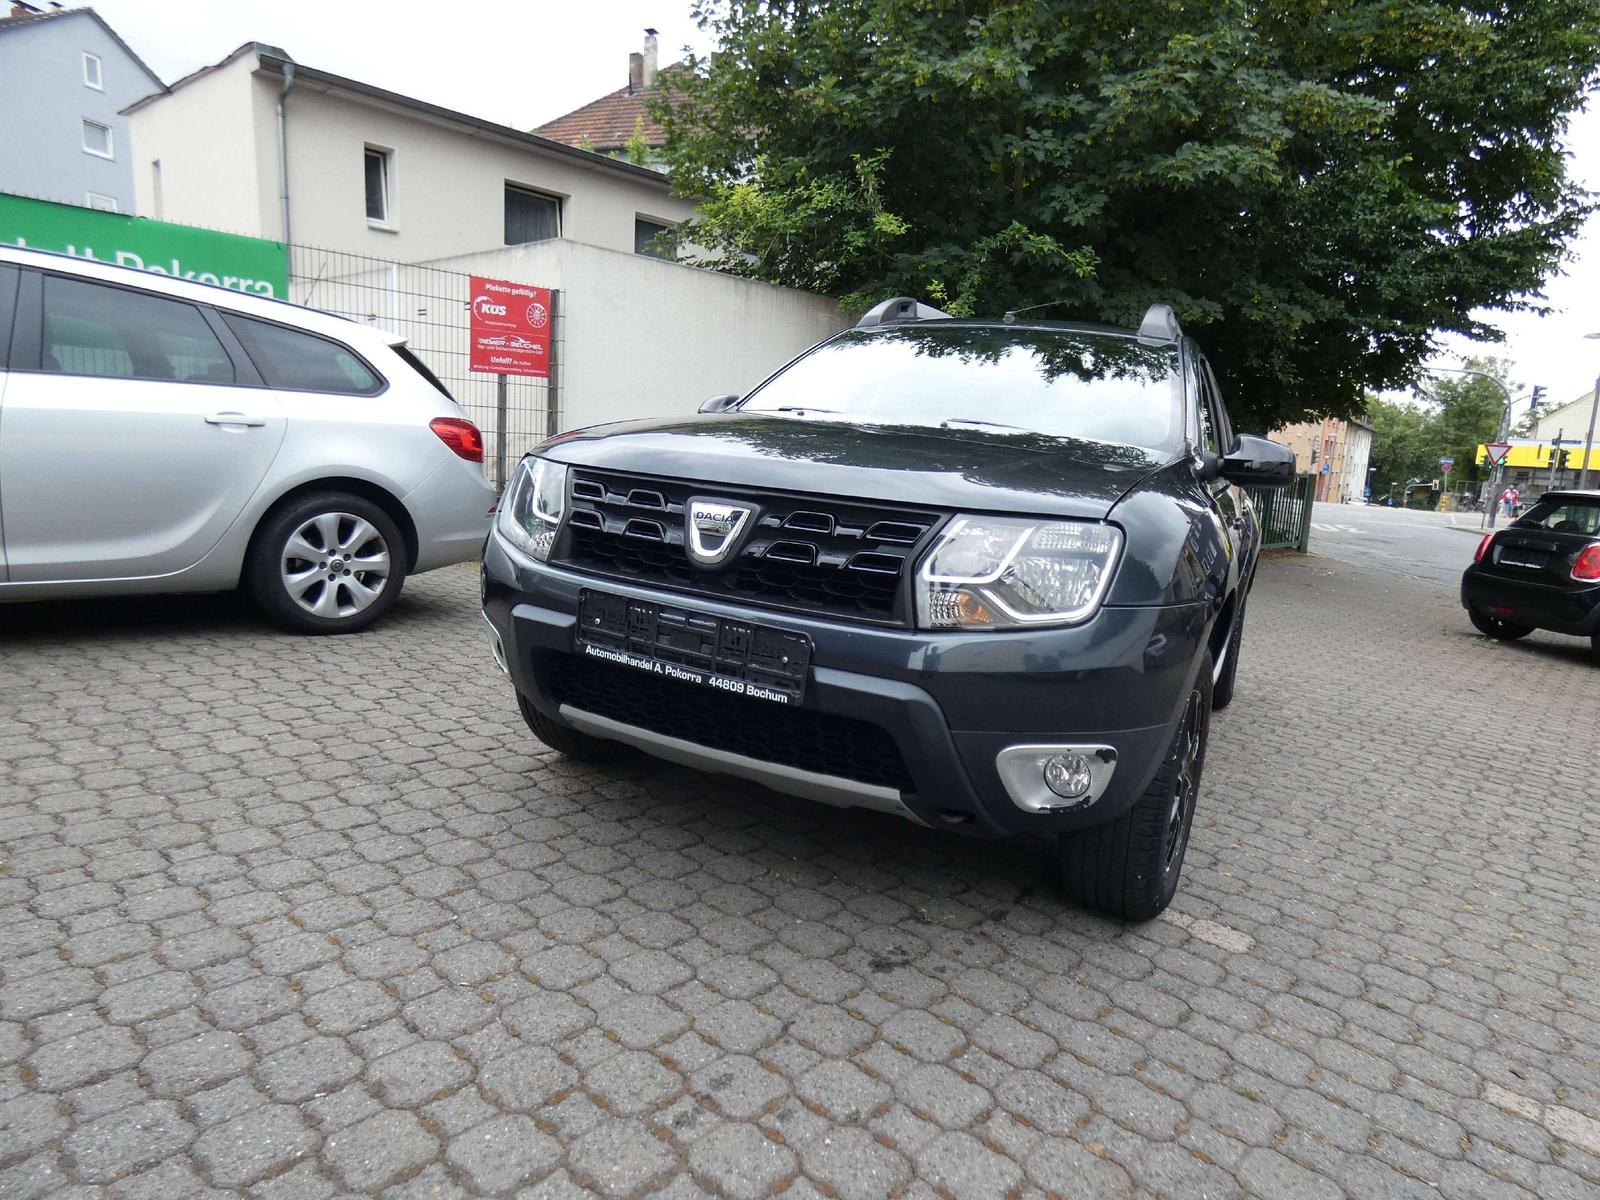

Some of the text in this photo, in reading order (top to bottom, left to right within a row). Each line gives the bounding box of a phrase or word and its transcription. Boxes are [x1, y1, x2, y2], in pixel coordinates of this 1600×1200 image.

[485, 283, 511, 294] Plakette
[490, 356, 513, 365] Unfall?
[696, 511, 734, 525] DACIA
[585, 645, 788, 704] Automobilhandel A. Pokorra 44809 Bochum
